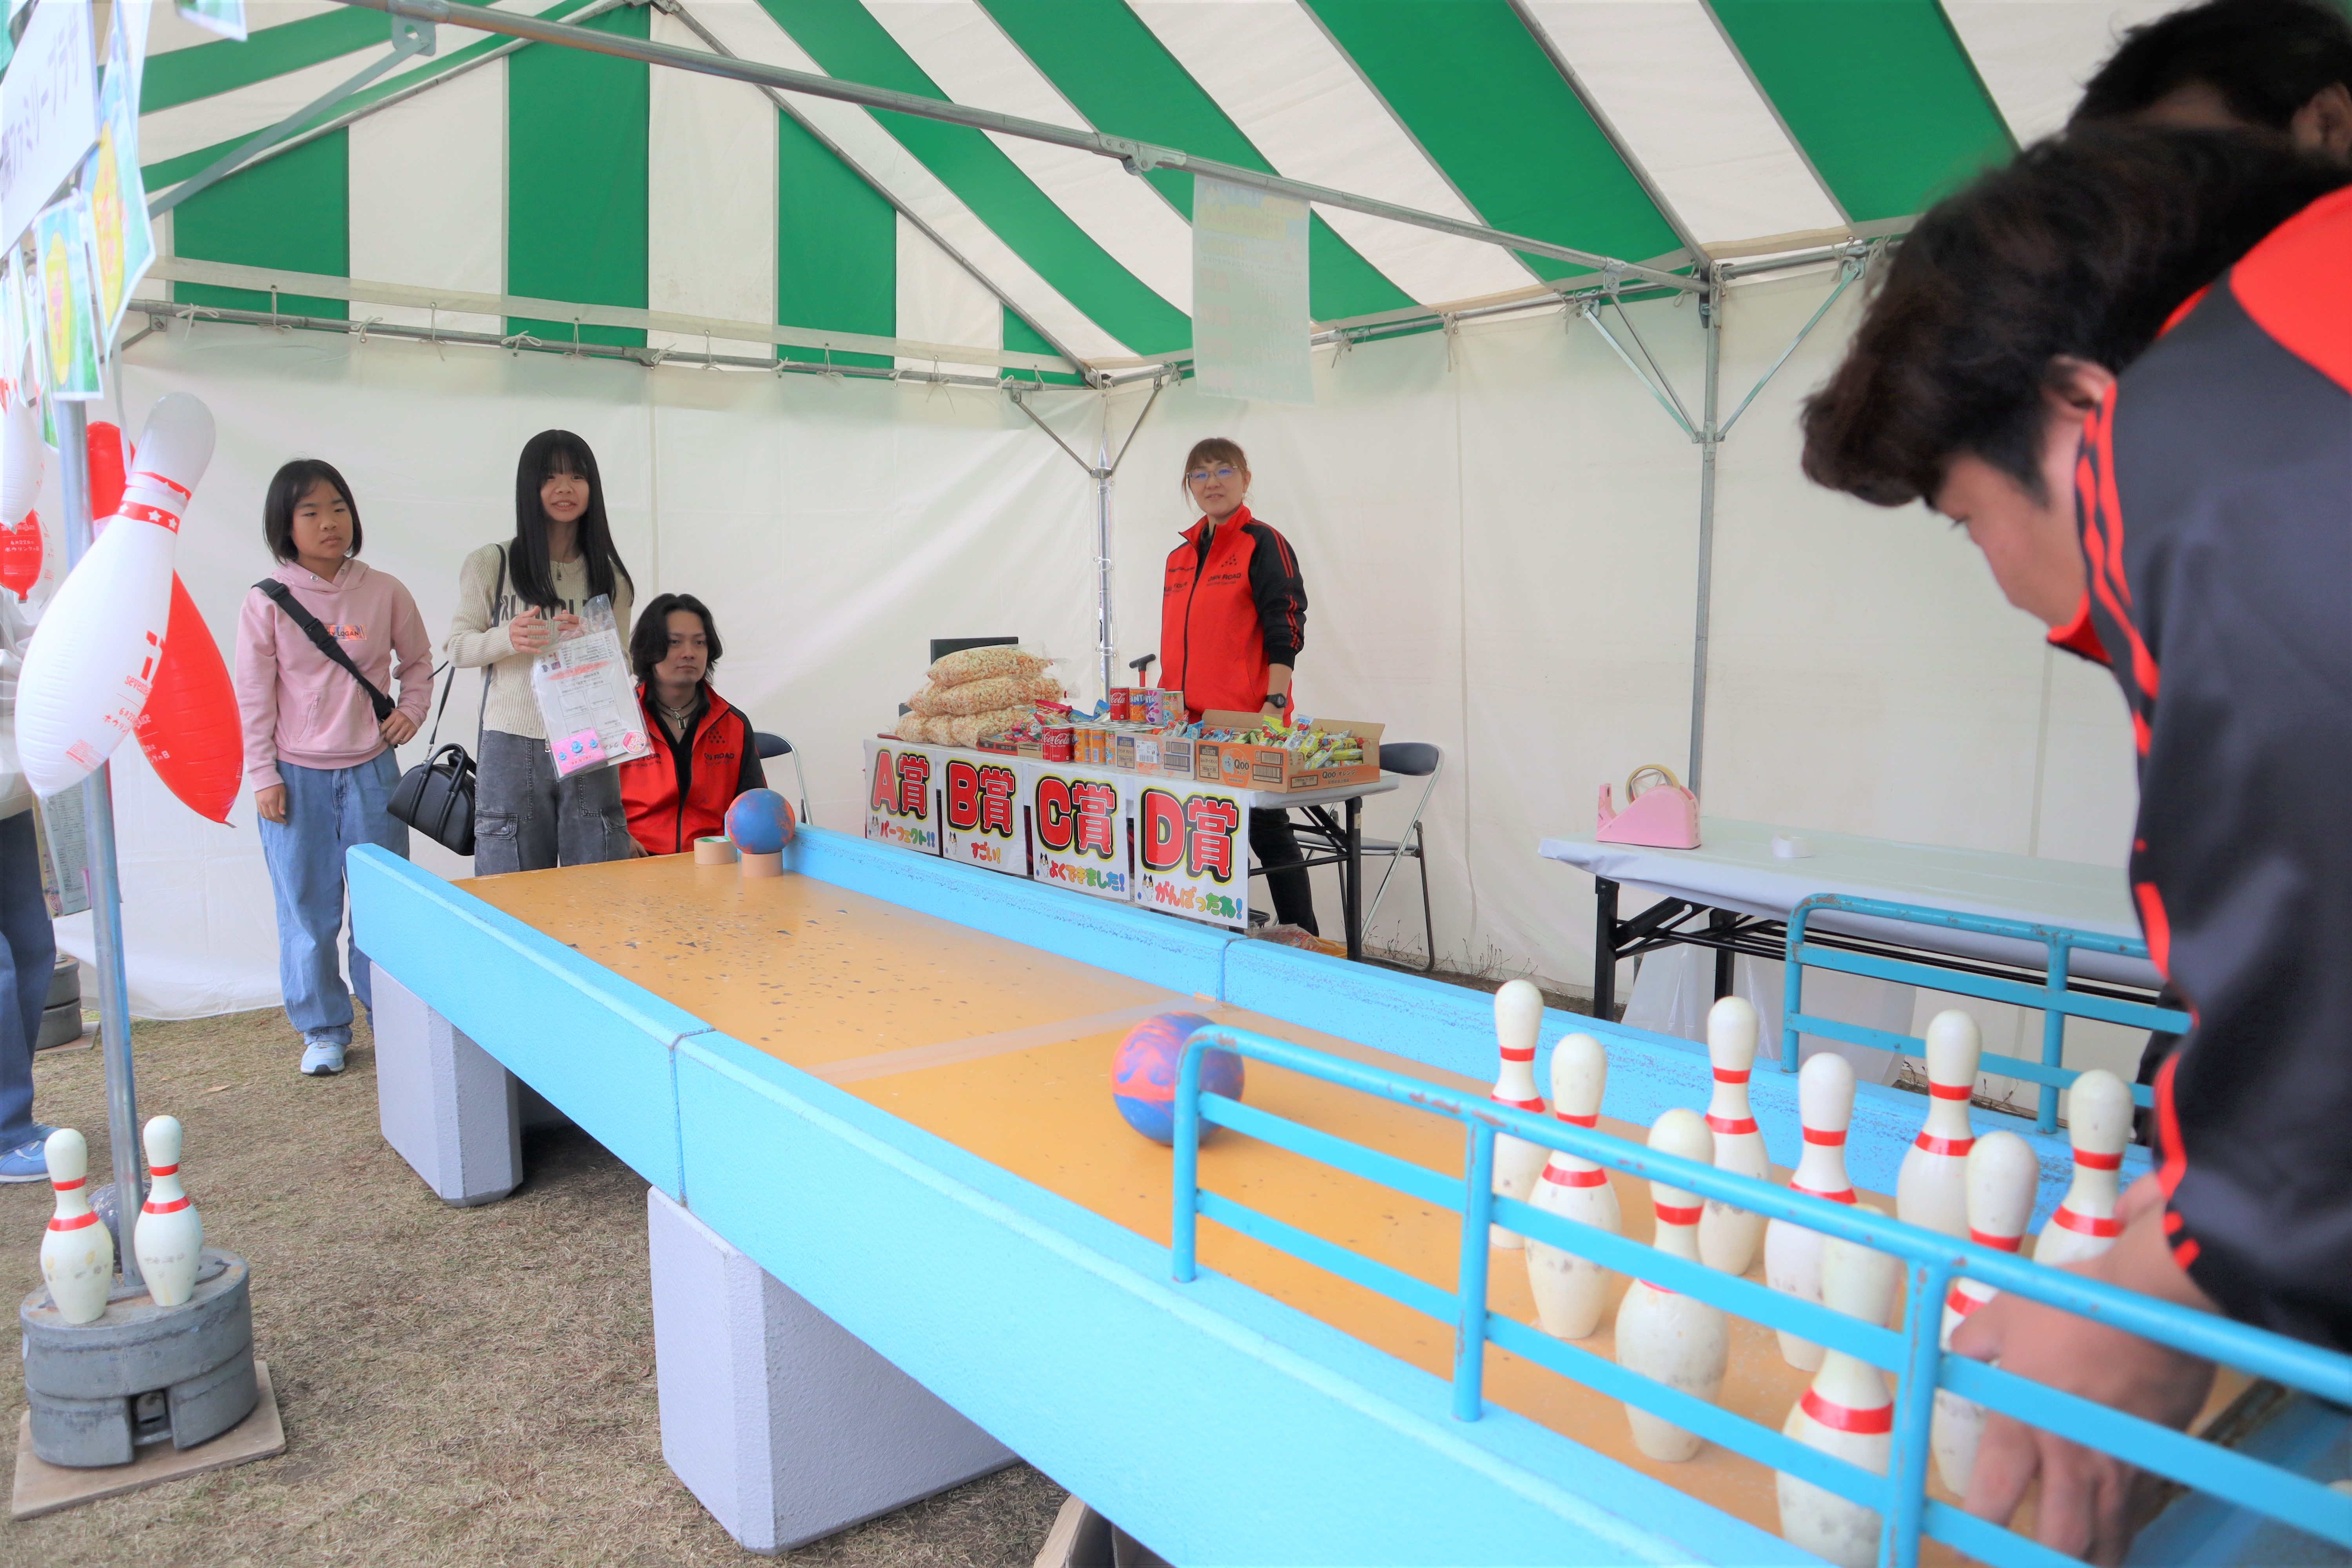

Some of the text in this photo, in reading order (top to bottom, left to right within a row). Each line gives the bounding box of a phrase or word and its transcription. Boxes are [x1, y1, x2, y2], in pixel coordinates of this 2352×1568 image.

[872, 750, 929, 817] A賞
[948, 762, 1014, 834] B賞
[1234, 759, 1249, 770] Qoo
[1322, 771, 1337, 779] Qoo
[1038, 779, 1115, 855] C賞
[1145, 791, 1238, 878] D賞
